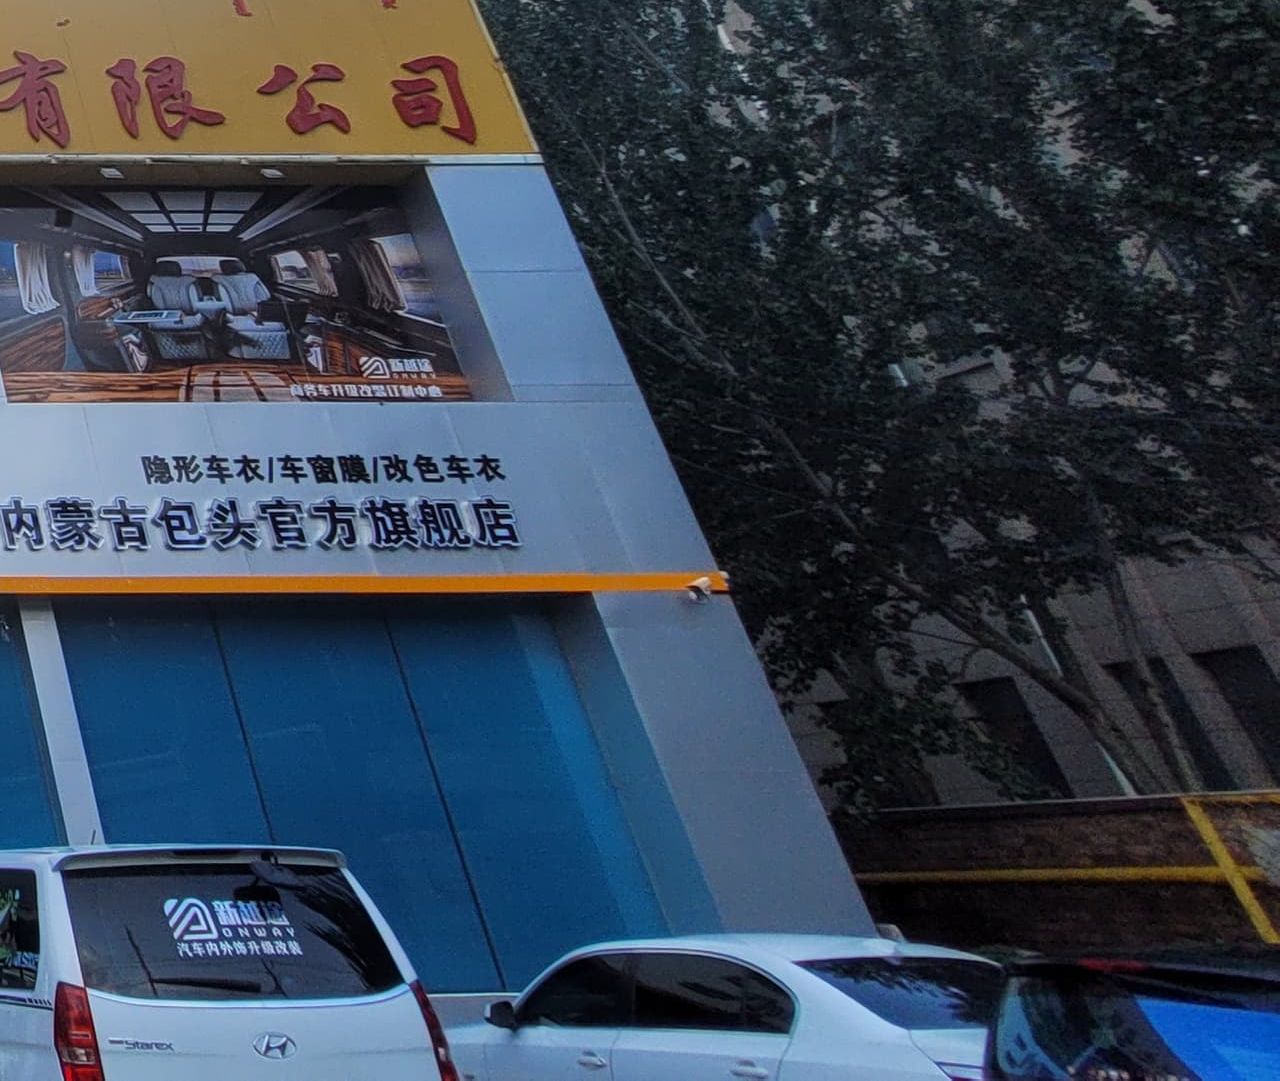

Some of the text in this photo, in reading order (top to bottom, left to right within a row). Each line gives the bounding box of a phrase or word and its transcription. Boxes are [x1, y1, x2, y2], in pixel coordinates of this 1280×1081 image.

[140, 454, 508, 485] 隐形车衣/车窗膜/改色车衣
[221, 926, 296, 938] ONWAY
[176, 940, 304, 958] 汽车内外饰升级改装
